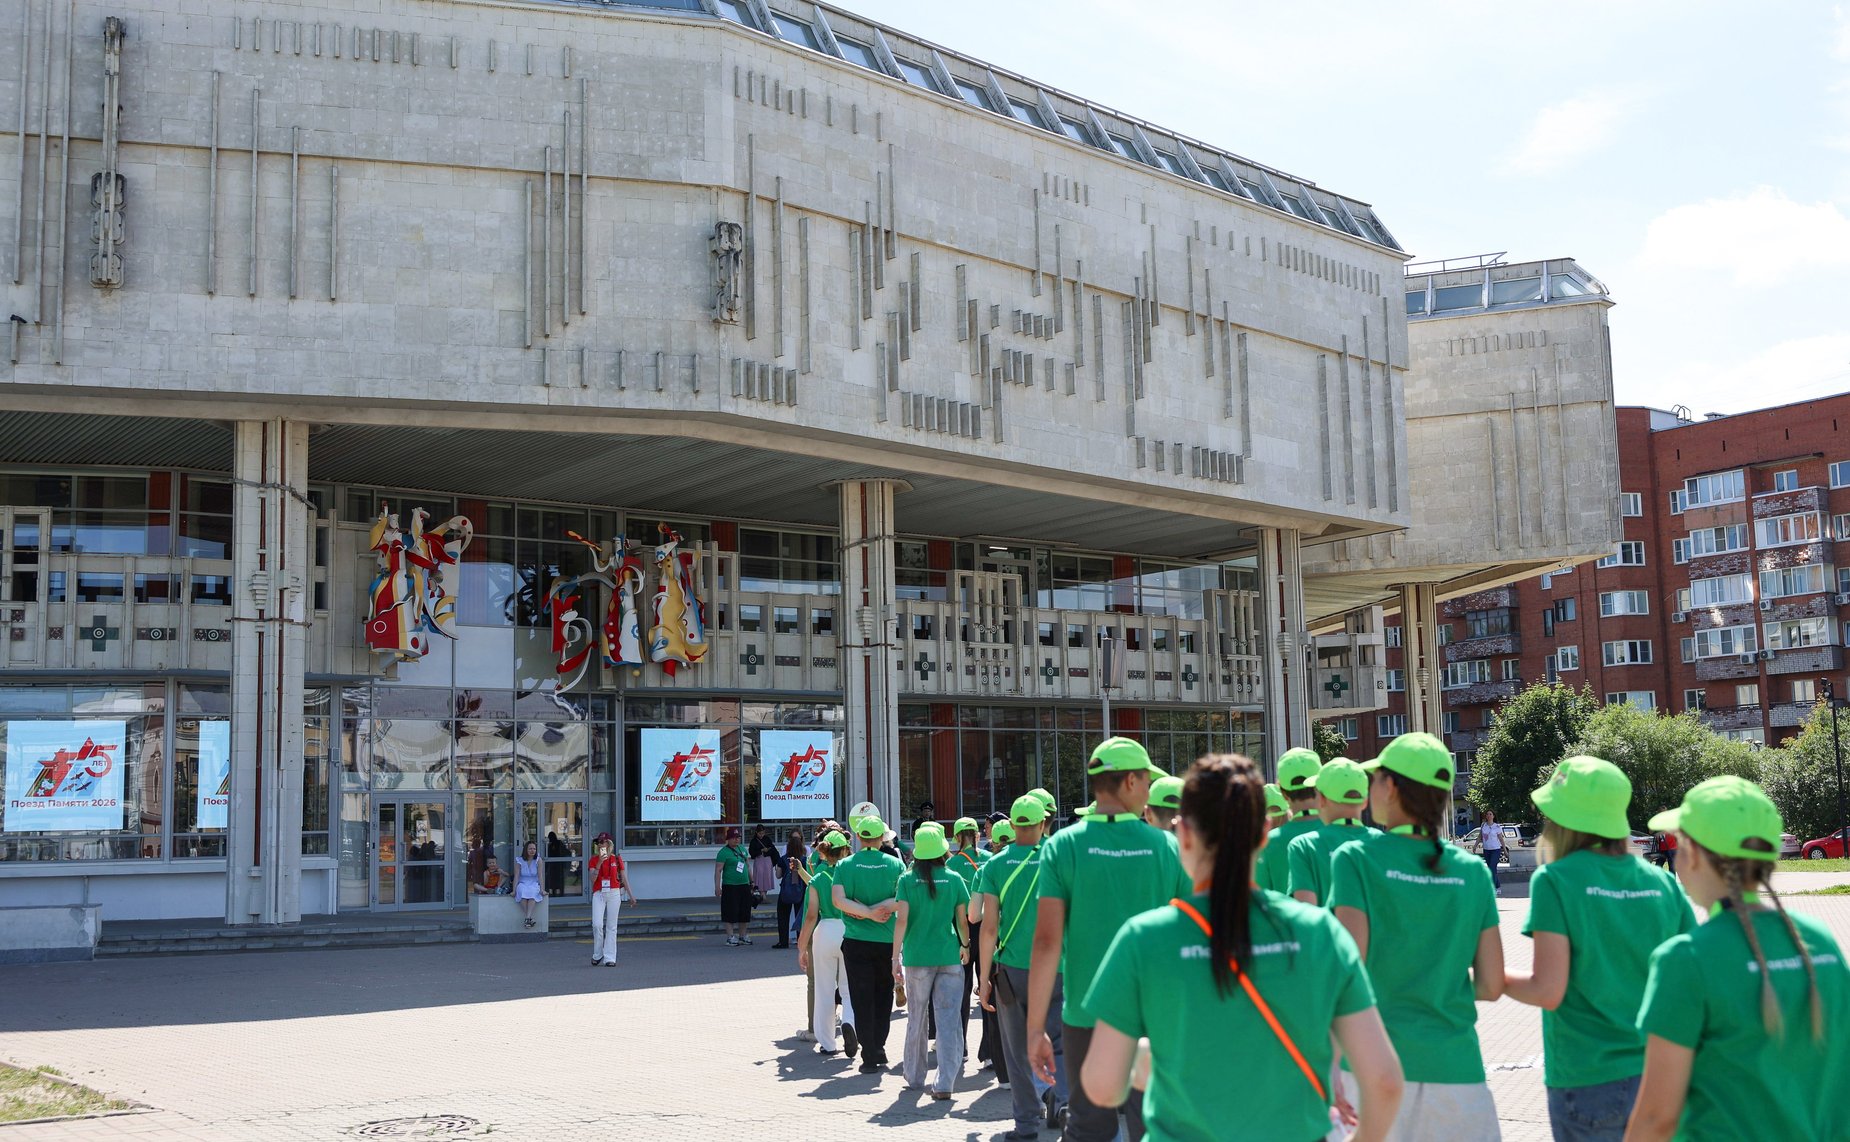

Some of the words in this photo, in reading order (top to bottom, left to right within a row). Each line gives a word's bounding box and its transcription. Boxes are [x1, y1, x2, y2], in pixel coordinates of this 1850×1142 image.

[764, 793, 786, 801] Поезд
[11, 800, 45, 809] Поезд
[47, 799, 88, 808] Памяти
[91, 798, 117, 807] 2026
[1087, 847, 1153, 858] #ПоездПамяти
[1386, 869, 1465, 886] #ПоездПамяти
[1586, 886, 1662, 900] #ПоездПамяти
